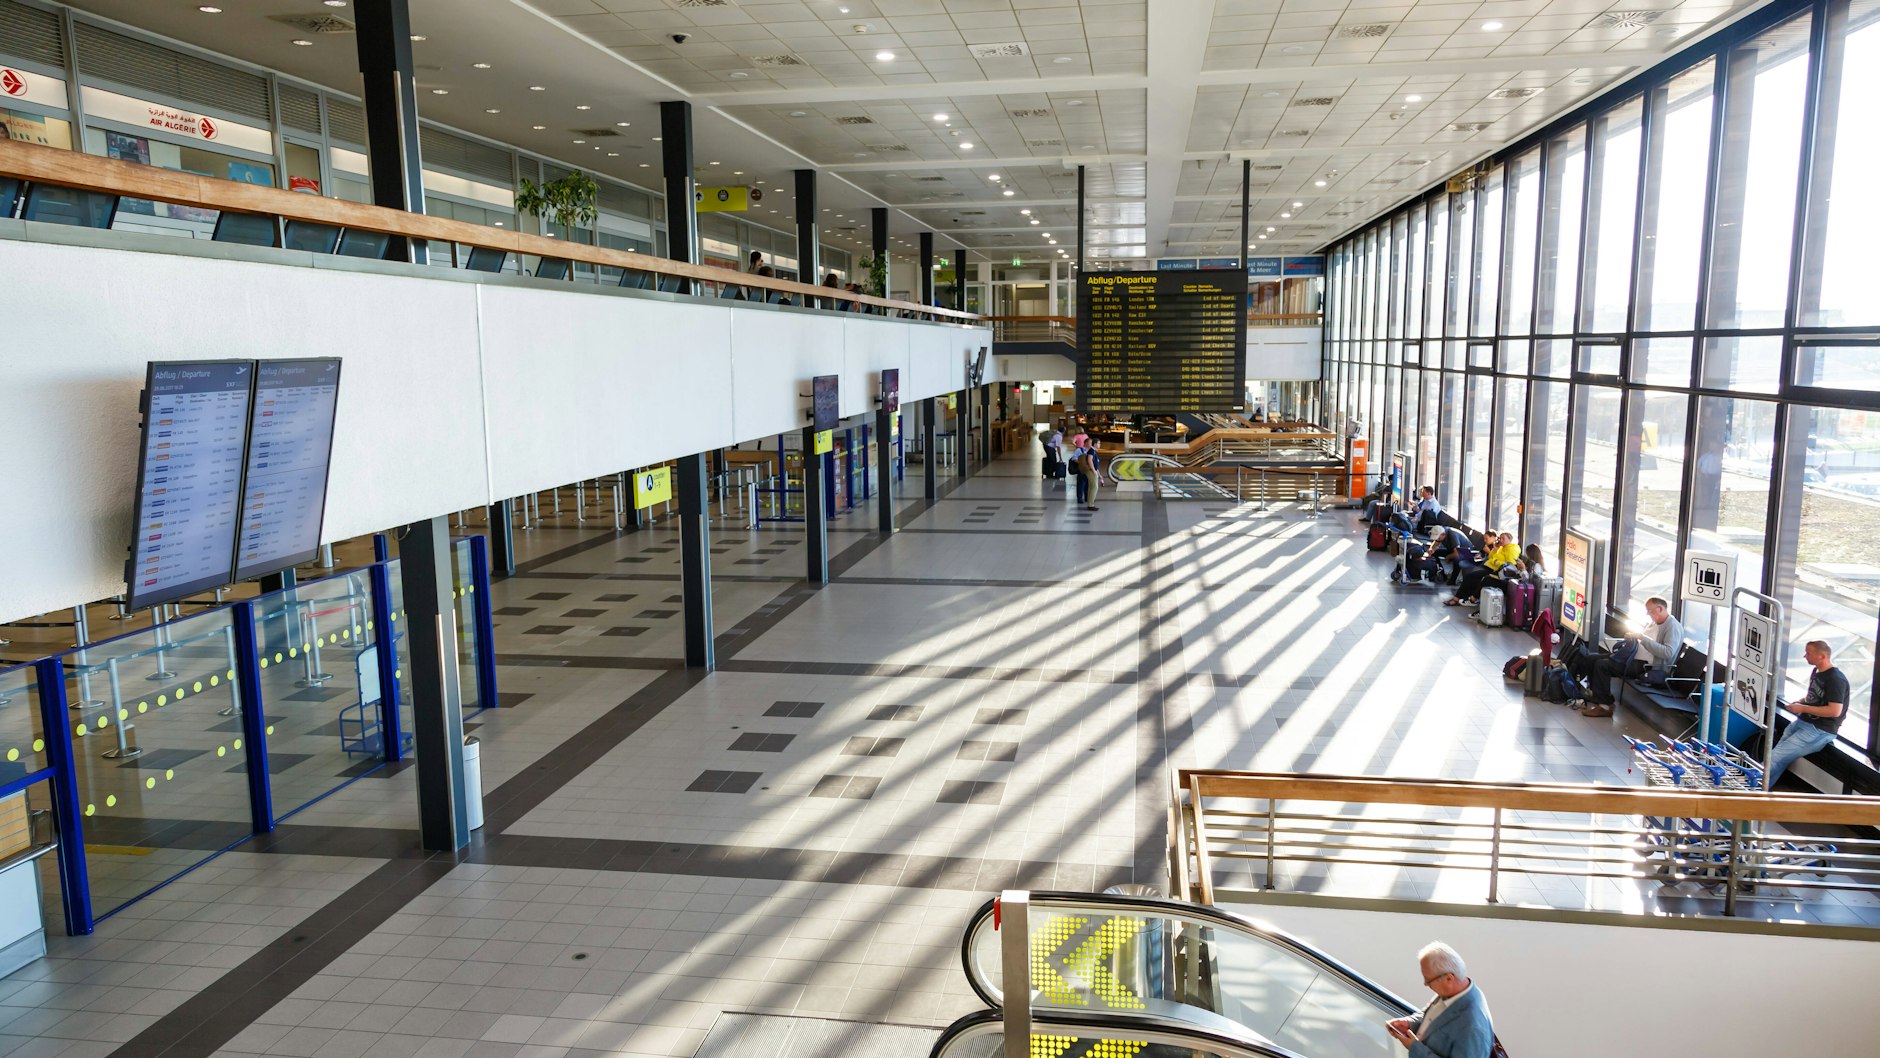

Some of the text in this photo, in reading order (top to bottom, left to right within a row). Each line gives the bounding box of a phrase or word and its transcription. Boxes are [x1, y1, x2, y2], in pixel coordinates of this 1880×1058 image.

[165, 122, 196, 134] ALGERIE
[1088, 276, 1157, 285] Abflug/Departure
[155, 371, 176, 380] Abflug
[182, 370, 211, 379] Departure
